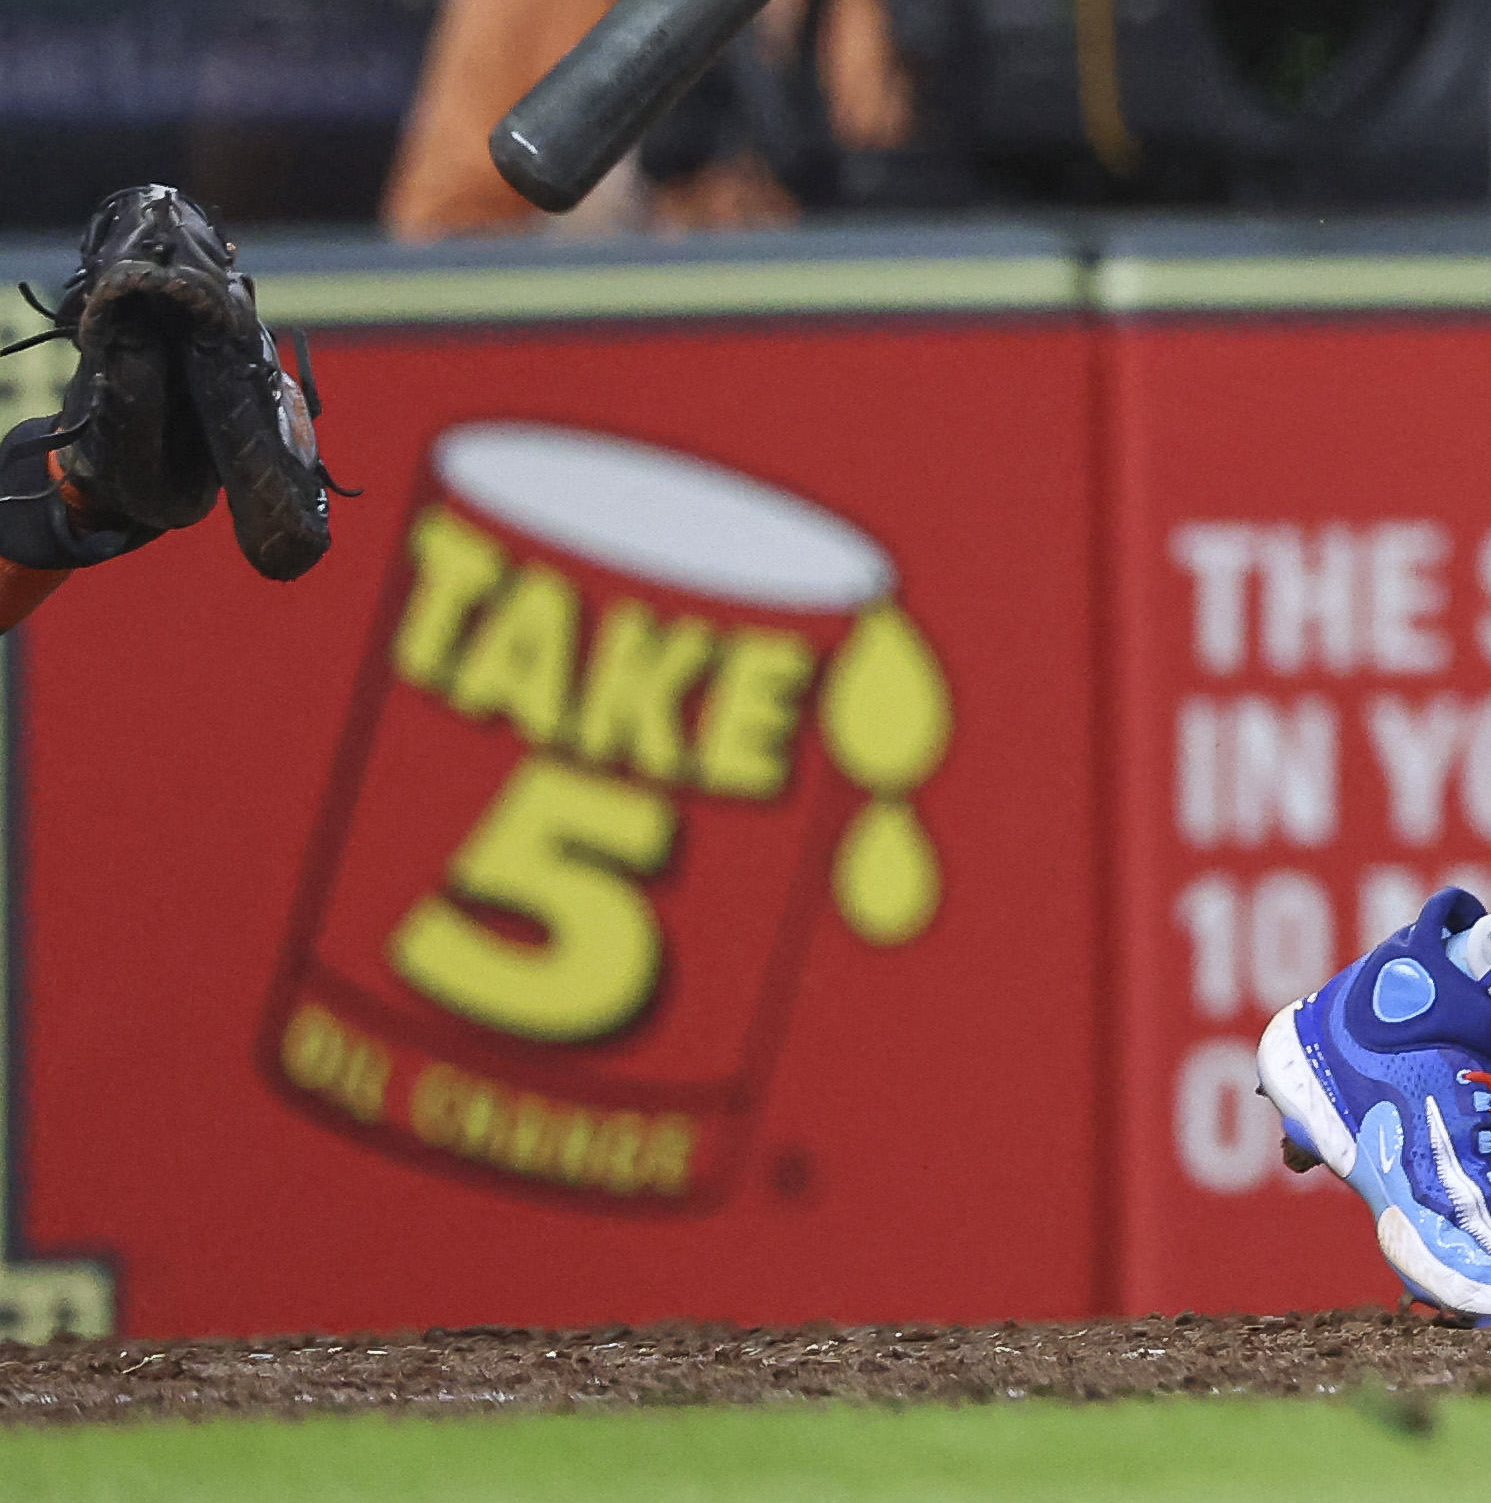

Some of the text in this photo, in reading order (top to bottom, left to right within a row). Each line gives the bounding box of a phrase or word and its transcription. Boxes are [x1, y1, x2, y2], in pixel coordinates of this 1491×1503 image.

[393, 505, 816, 799] TAKE
[1171, 517, 1454, 677] THE
[1176, 690, 1339, 850] IN
[384, 750, 682, 1044] 5
[1175, 867, 1336, 1023] 10
